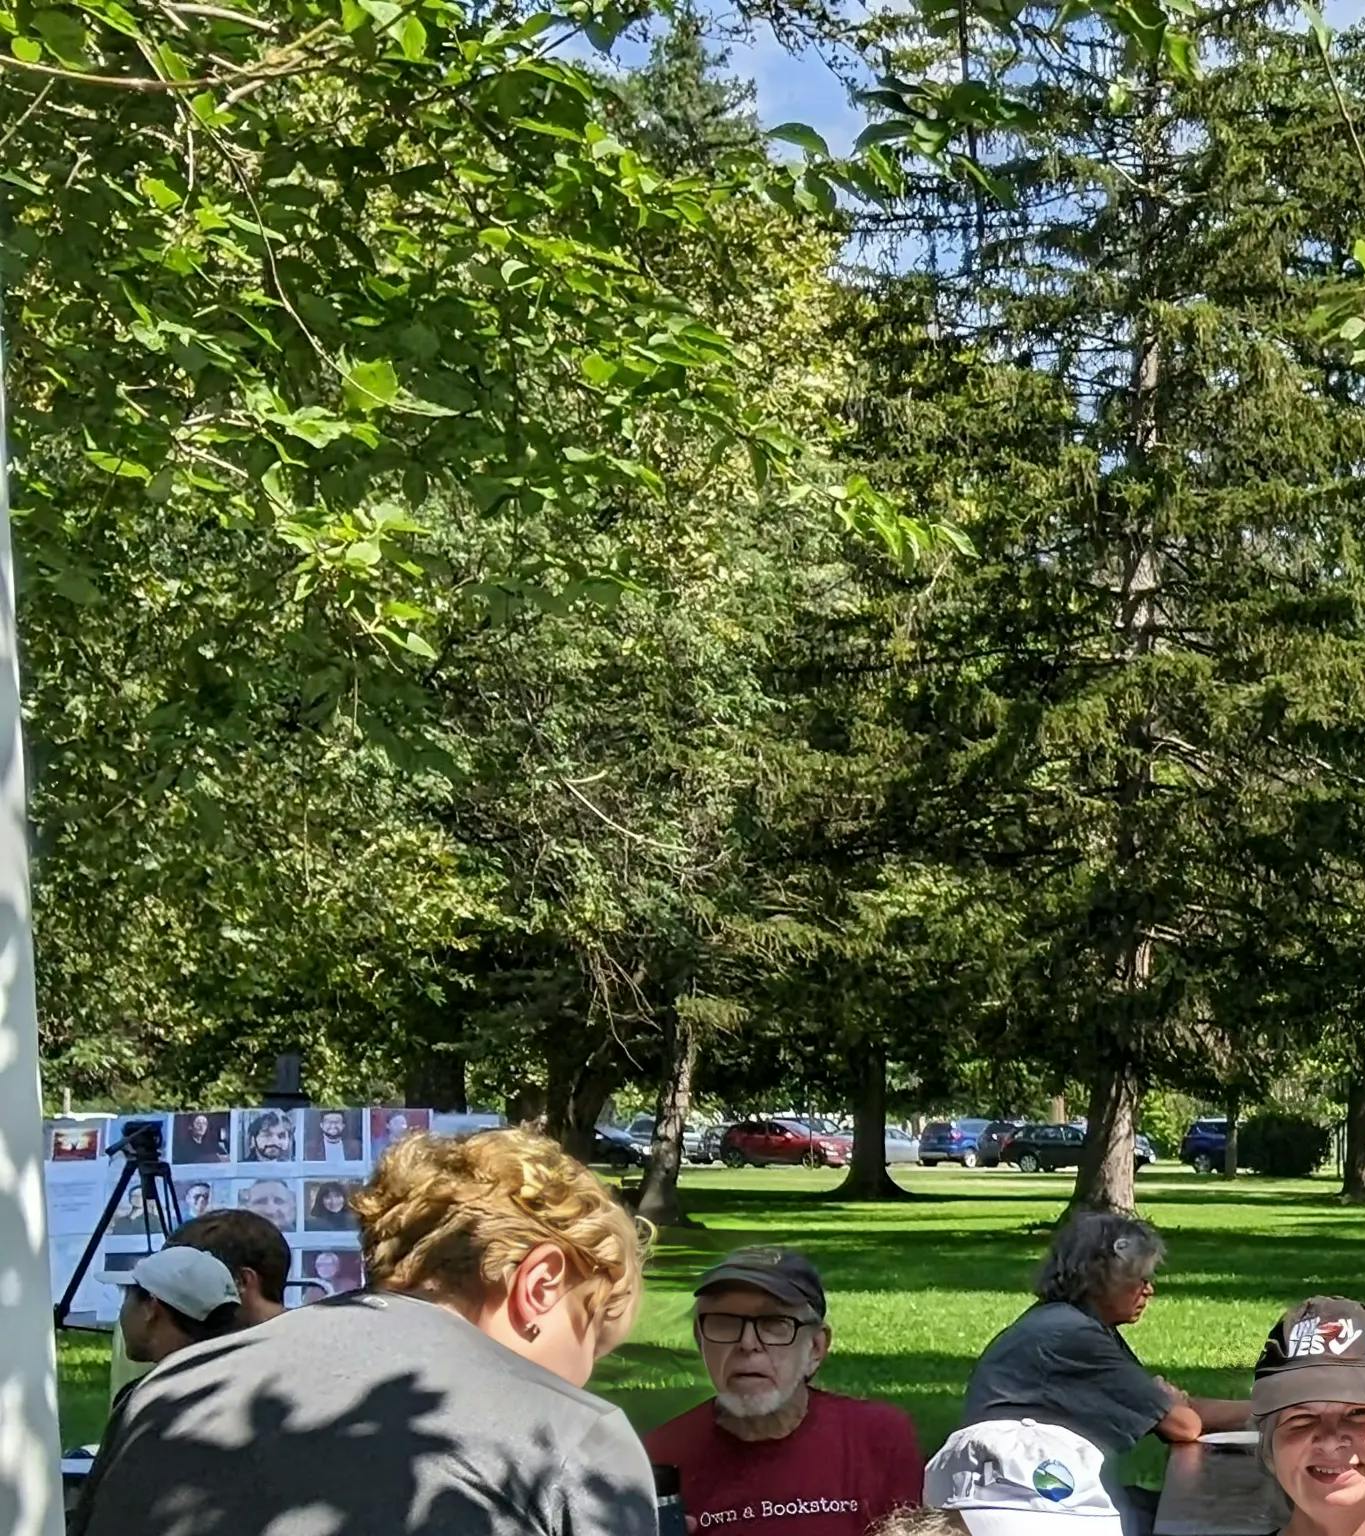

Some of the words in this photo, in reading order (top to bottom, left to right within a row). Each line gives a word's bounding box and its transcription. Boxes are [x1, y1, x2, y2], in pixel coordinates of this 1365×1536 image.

[700, 1510, 737, 1527] Own
[743, 1507, 755, 1518] a
[761, 1497, 858, 1517] Bookstore
